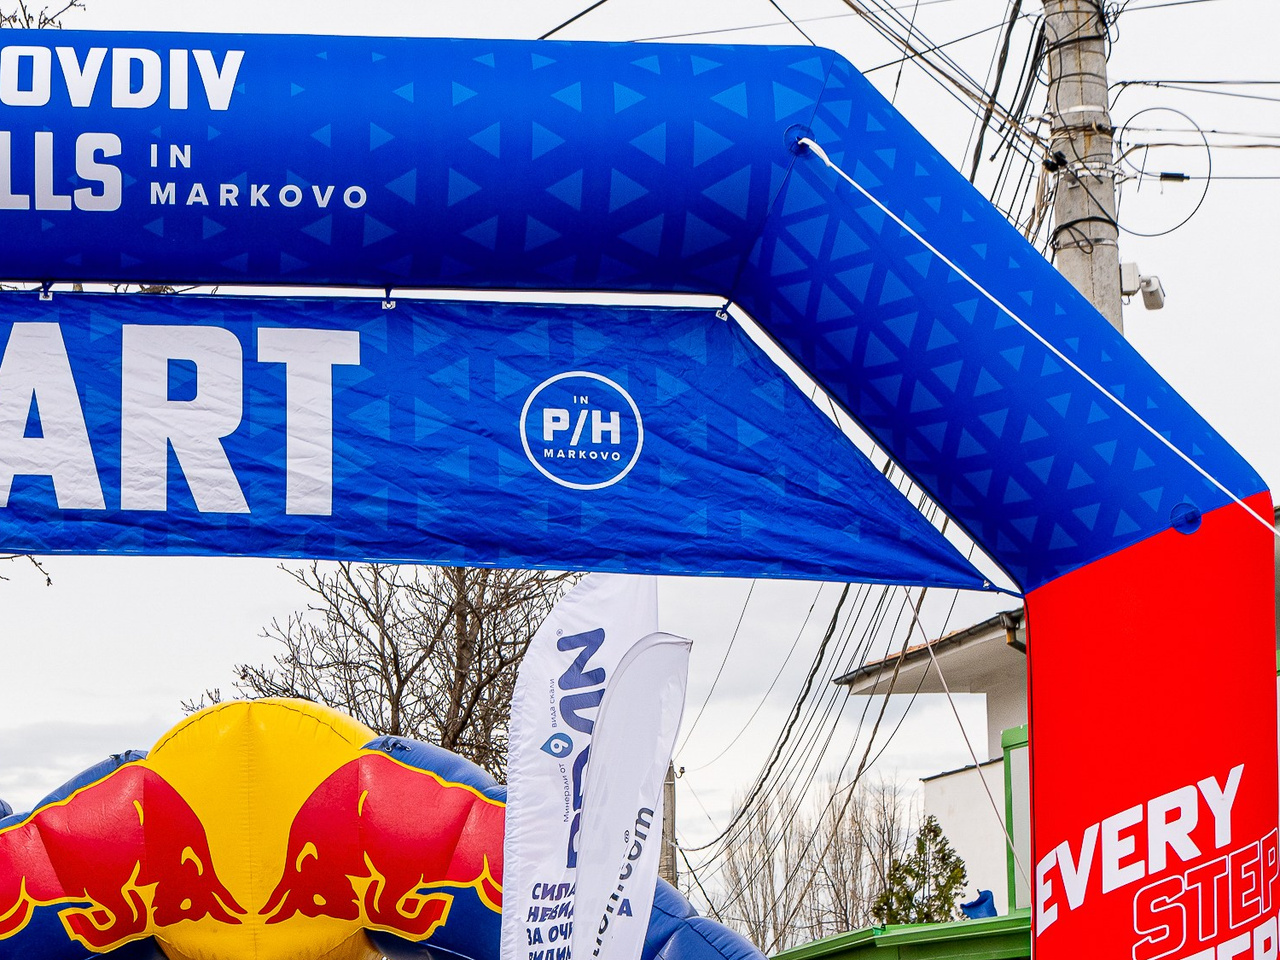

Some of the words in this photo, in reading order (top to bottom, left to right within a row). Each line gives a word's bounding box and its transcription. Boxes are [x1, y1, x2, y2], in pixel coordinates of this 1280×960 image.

[149, 144, 192, 169] IN
[149, 181, 368, 209] MARKOVO
[573, 395, 589, 405] IN
[542, 407, 621, 446] P/H
[543, 448, 621, 461] MARKOVO
[548, 678, 556, 704] скали
[549, 706, 557, 728] вида
[549, 738, 568, 755] 9
[559, 763, 566, 774] от
[562, 776, 571, 823] Минерали
[1035, 763, 1245, 938] EVERY
[526, 927, 543, 946] ЗА
